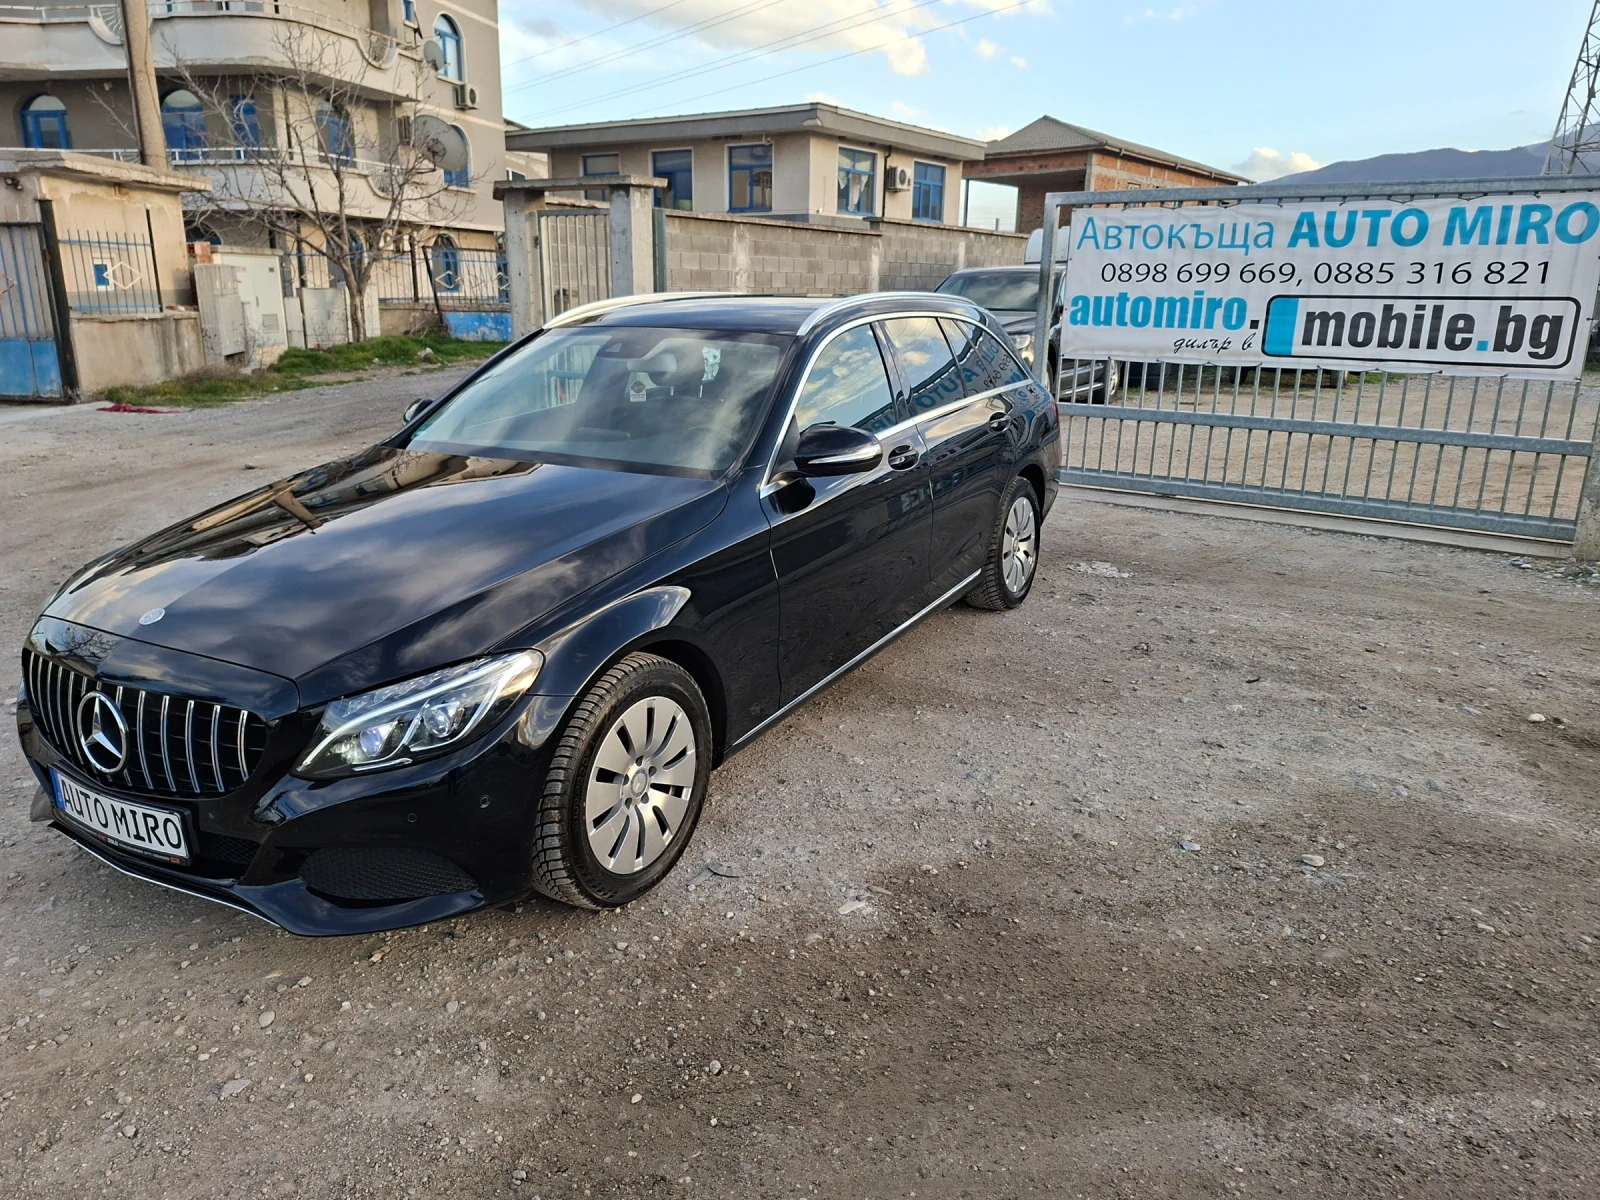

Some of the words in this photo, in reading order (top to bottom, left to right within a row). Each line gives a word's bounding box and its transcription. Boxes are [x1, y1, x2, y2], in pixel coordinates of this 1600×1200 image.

[1076, 216, 1274, 256] Автокъща
[1287, 208, 1429, 248] AUTO
[1442, 202, 1600, 246] MIRO
[1101, 262, 1167, 283] 0898
[1176, 262, 1230, 284] 699
[1239, 262, 1303, 287] 669,
[1314, 262, 1395, 284] 0885
[1406, 261, 1472, 284] 316
[1484, 261, 1550, 284] 821
[1173, 337, 1232, 354] дилър
[1241, 332, 1256, 351] в
[1301, 304, 1563, 360] mobile.bg
[61, 779, 109, 829] AUTO
[110, 803, 182, 849] MIRO
